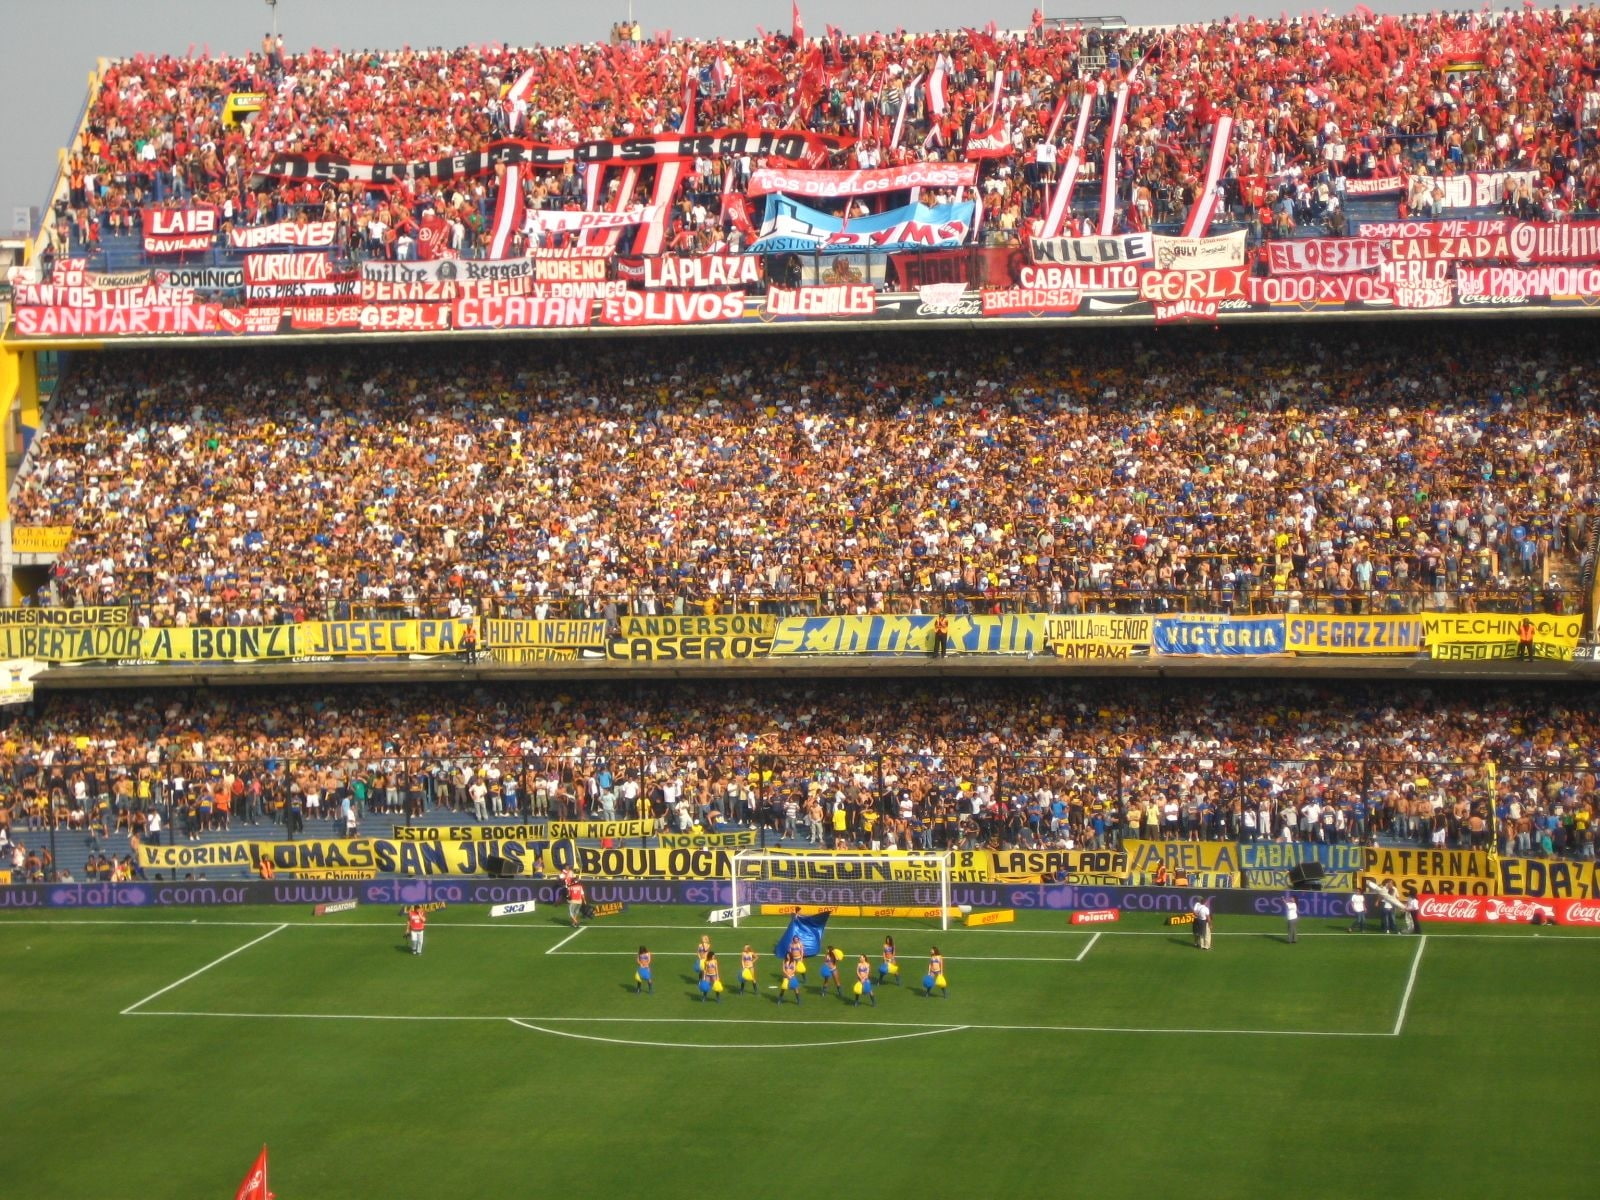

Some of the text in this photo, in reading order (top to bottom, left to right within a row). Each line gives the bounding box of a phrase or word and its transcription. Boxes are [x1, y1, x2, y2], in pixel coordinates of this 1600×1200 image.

[805, 178, 889, 197] DIABLOS
[895, 171, 960, 186] ROJOS
[231, 221, 337, 247] VIRREYES
[1360, 223, 1427, 237] RAMOS
[145, 238, 209, 250] GAVILAN
[1032, 237, 1147, 261] WILDE
[1392, 237, 1509, 259] CALZADA
[1271, 240, 1382, 269] EL OESTE
[53, 271, 83, 286] 30
[169, 271, 243, 287] DOMINICO
[466, 261, 531, 280] Reggae
[536, 260, 605, 279] MORENO
[1021, 266, 1137, 288] CABALLITO
[1381, 261, 1447, 283] MERLO
[250, 281, 355, 299] LOS PIBES DEL SUR
[1141, 270, 1246, 300] GERLI
[16, 285, 194, 309] SANTOS LUGARES
[985, 289, 1083, 309] BRANDSEN
[361, 305, 450, 329] GERLI
[38, 608, 127, 624] NOGUES
[627, 616, 762, 636] ANDERSON
[490, 621, 603, 643] HURLINGHAM
[1049, 620, 1093, 640] CAPILLA
[1110, 618, 1148, 640] SEÑOR
[1165, 626, 1277, 647] VICTORIA
[1289, 619, 1420, 647] SPEGAZZINI
[608, 637, 773, 660] CASEROS
[1055, 643, 1128, 659] CAMPANA
[1437, 645, 1486, 659] PASO
[394, 827, 438, 840] ESTO
[450, 827, 472, 840] ES
[550, 820, 652, 838] SAN MIGUEL
[662, 834, 751, 848] NOGUES
[373, 839, 450, 875] SAN
[1240, 845, 1361, 868] CABALLITO
[874, 907, 896, 917] easy
[982, 913, 999, 923] easy
